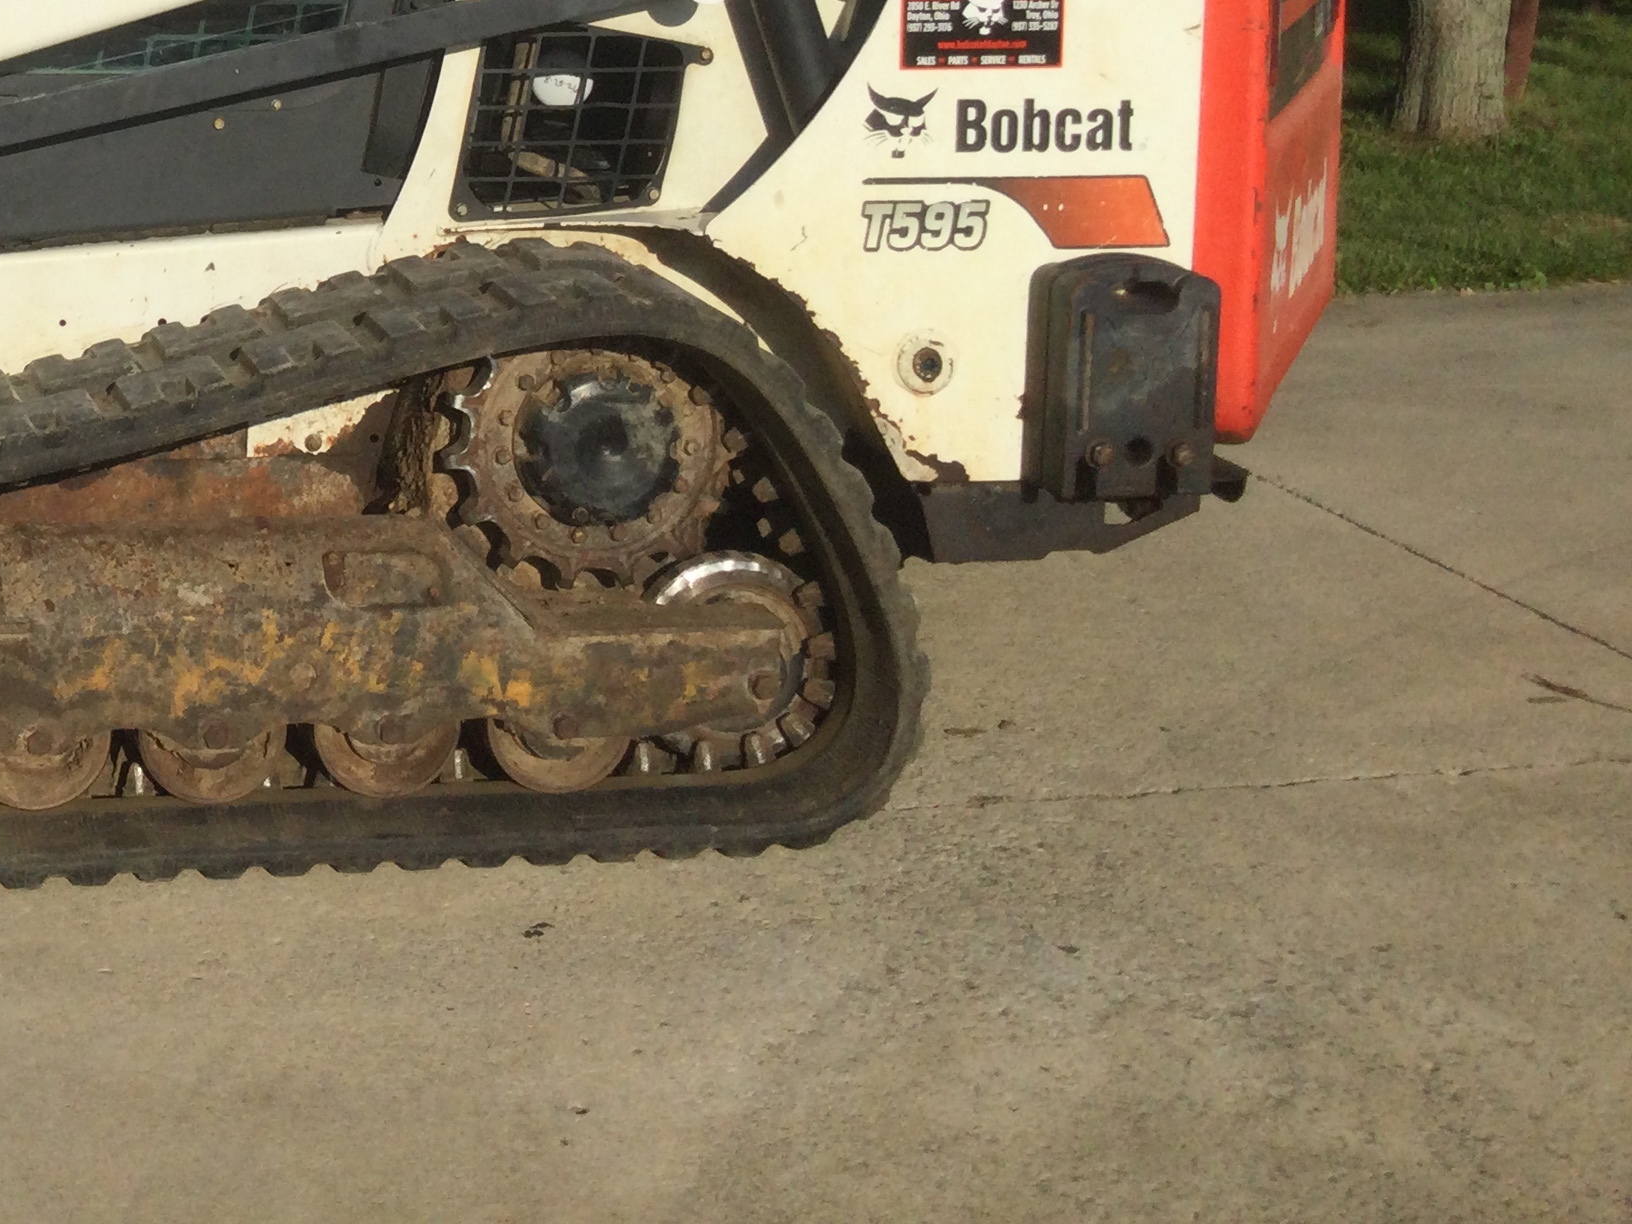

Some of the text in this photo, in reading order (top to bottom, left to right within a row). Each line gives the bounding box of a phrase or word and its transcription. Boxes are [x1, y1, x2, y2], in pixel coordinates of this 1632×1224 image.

[932, 1, 949, 10] River
[950, 1, 960, 10] Rd
[907, 11, 950, 22] Dayton, Ohio
[1025, 10, 1059, 20] Troy, Ohio
[915, 54, 1047, 66] SALES PARTS SERVICE RENTALS
[955, 98, 1134, 154] Bobcat
[861, 199, 991, 252] T595
